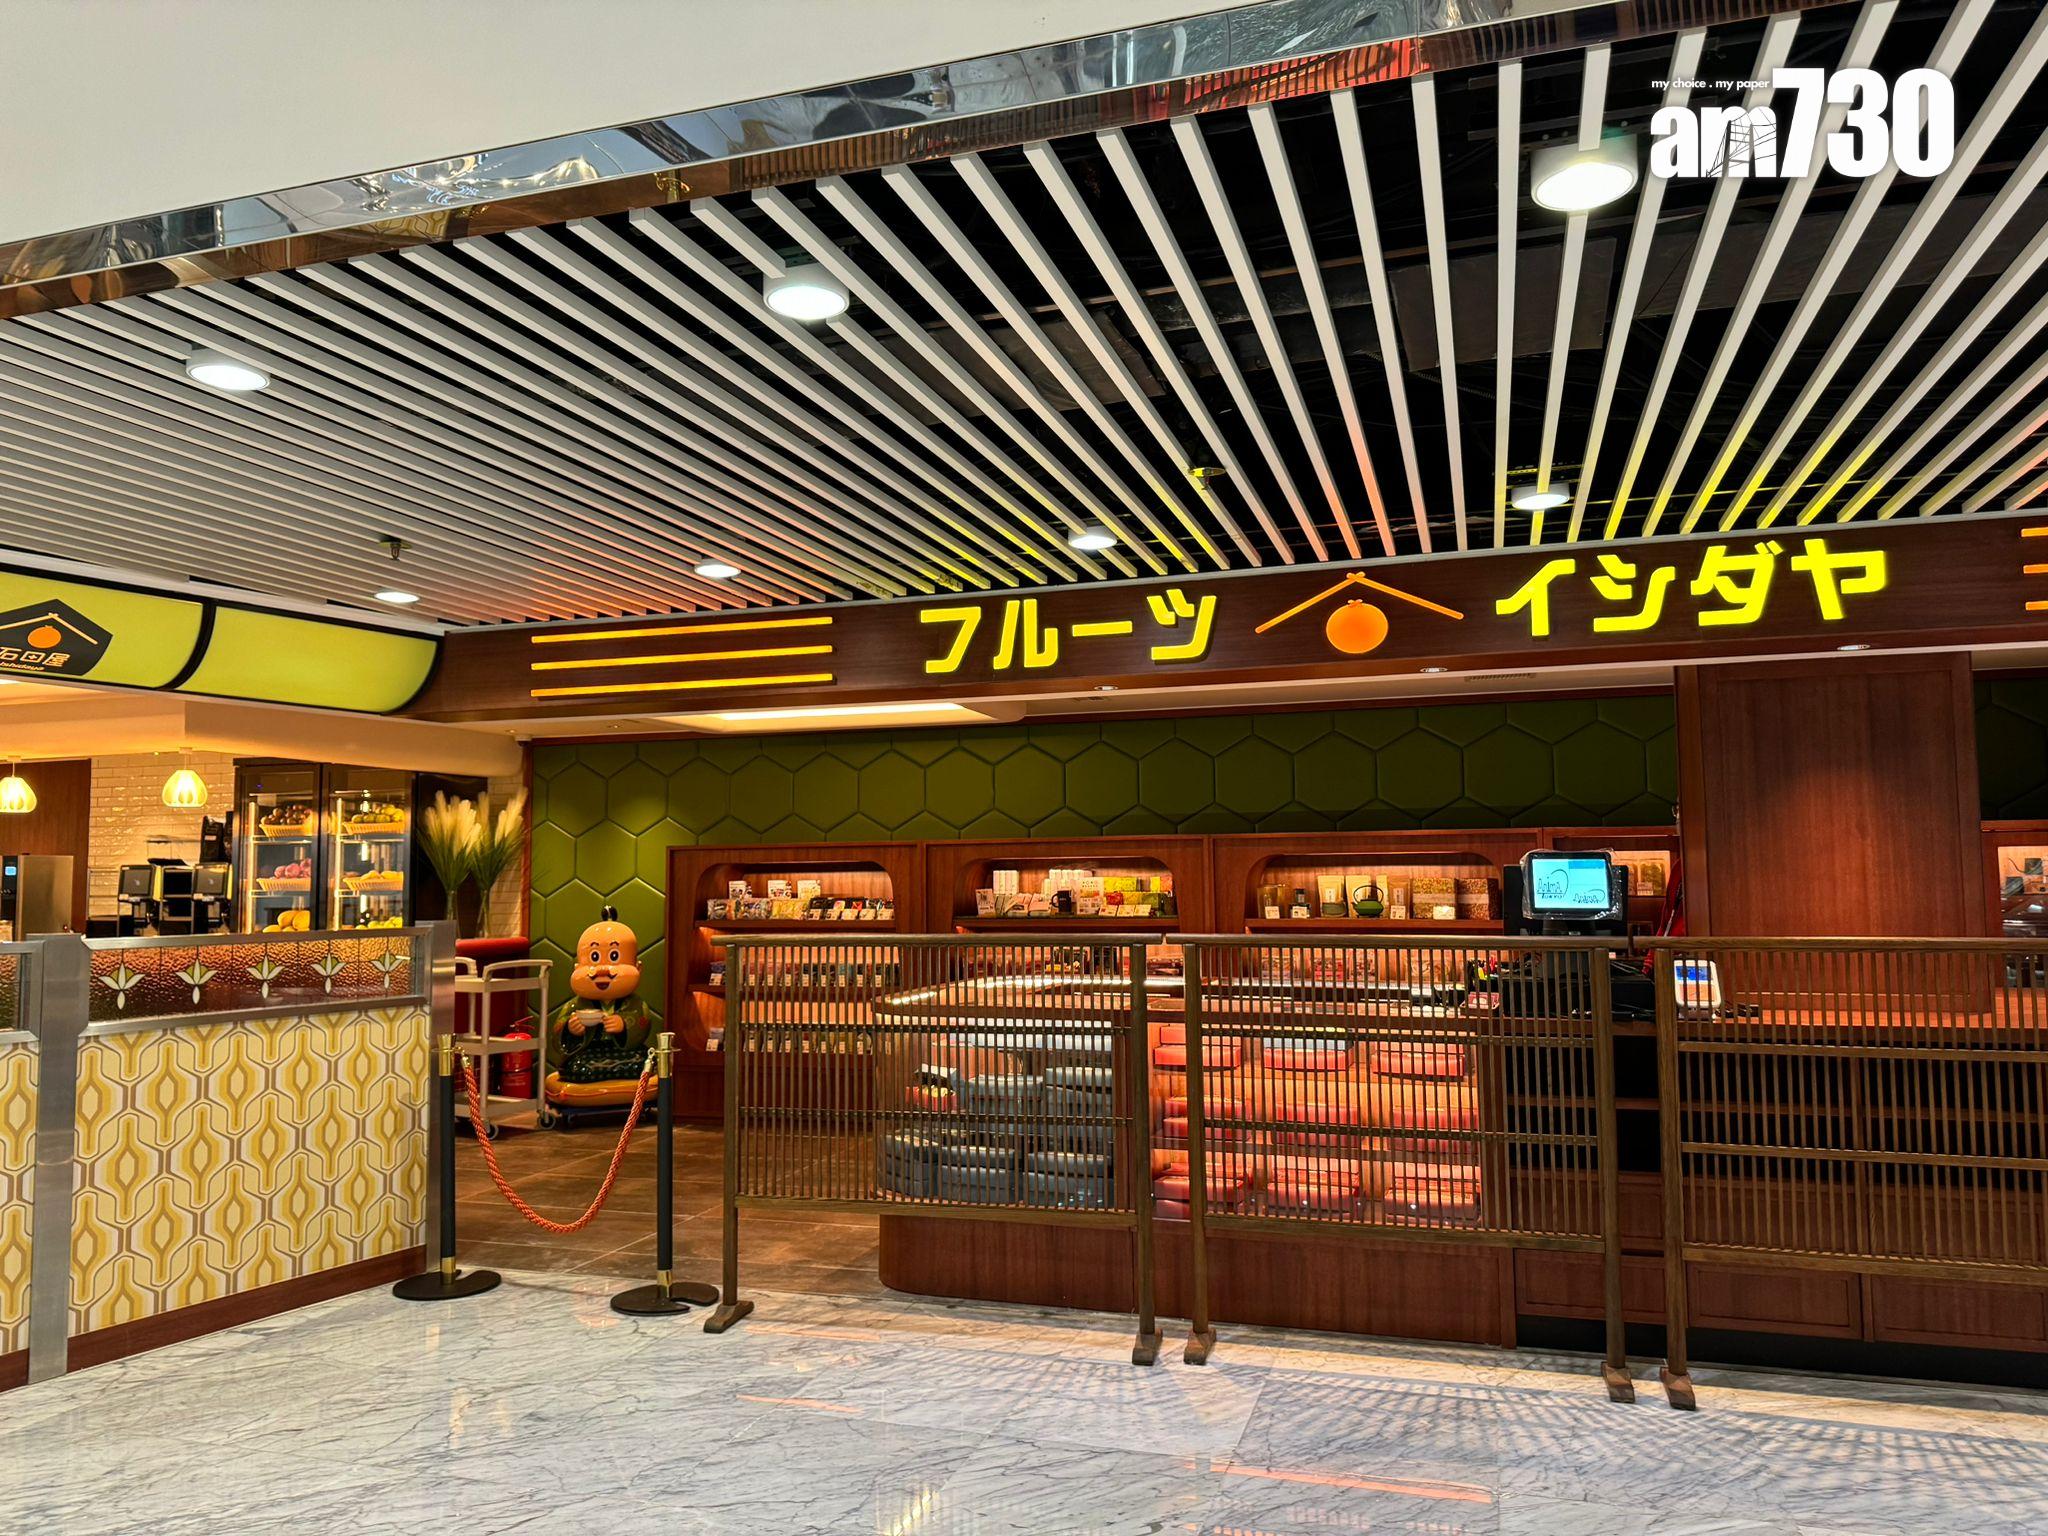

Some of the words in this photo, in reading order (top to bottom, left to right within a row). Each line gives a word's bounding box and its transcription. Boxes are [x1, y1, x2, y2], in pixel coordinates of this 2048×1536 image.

[920, 588, 1217, 674] フルーツ
[1495, 538, 1887, 636] イシダヤ
